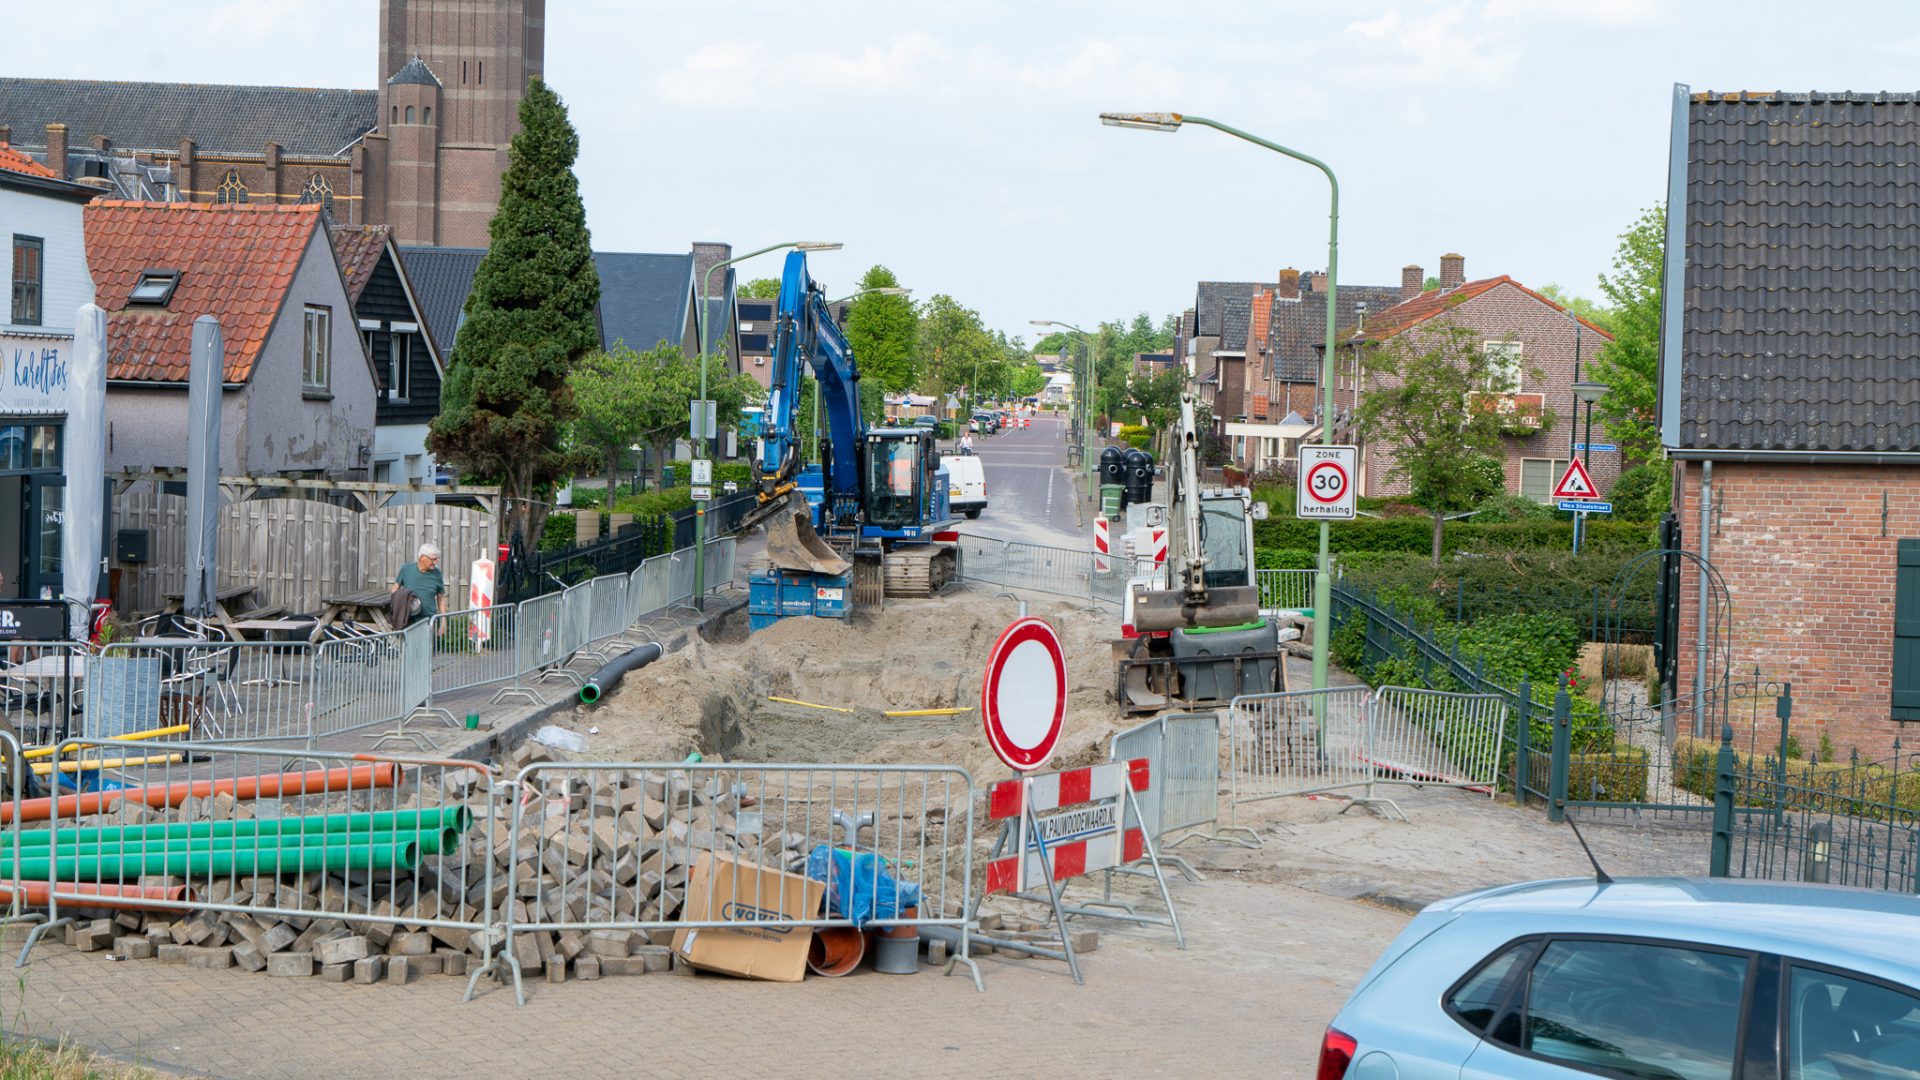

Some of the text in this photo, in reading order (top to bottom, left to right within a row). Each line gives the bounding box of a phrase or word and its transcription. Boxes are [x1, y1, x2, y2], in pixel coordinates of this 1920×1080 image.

[1316, 451, 1341, 459] ZONE
[1314, 475, 1341, 490] 30
[1303, 505, 1350, 515] herhaling
[0, 610, 21, 628] R.
